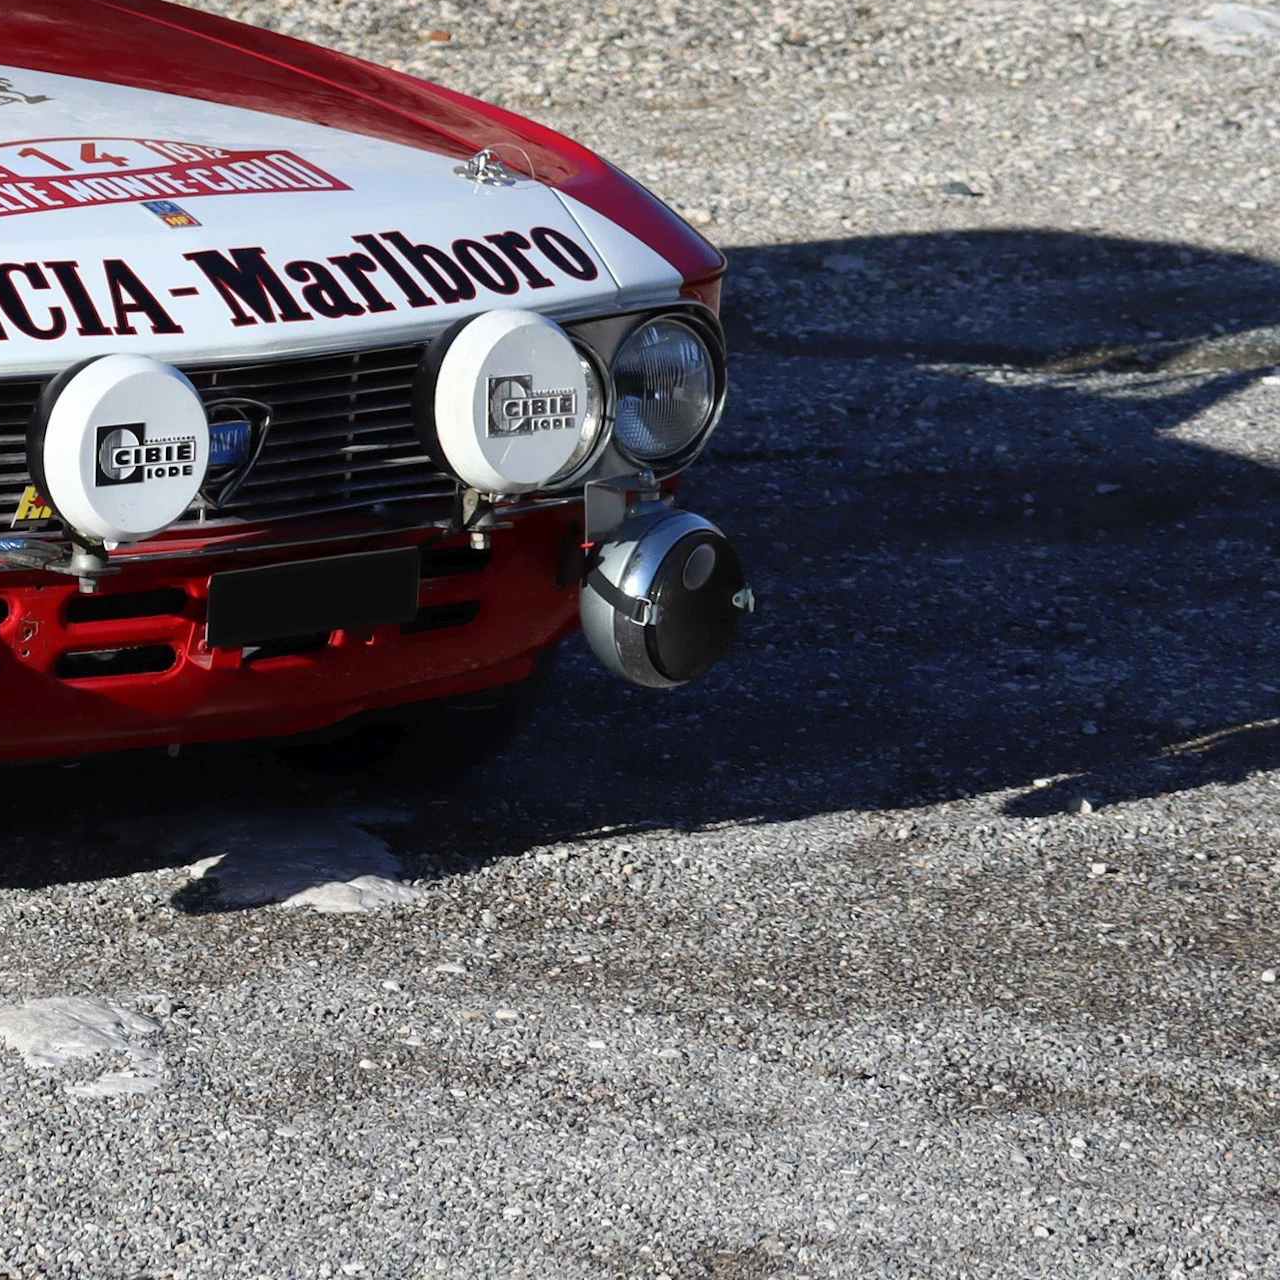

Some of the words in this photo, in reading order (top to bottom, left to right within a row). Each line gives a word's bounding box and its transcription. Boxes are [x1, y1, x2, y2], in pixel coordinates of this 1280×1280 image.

[17, 142, 130, 173] 14
[144, 140, 231, 163] 1972
[53, 153, 334, 206] MONTE-CARLO
[146, 465, 194, 480] IODE
